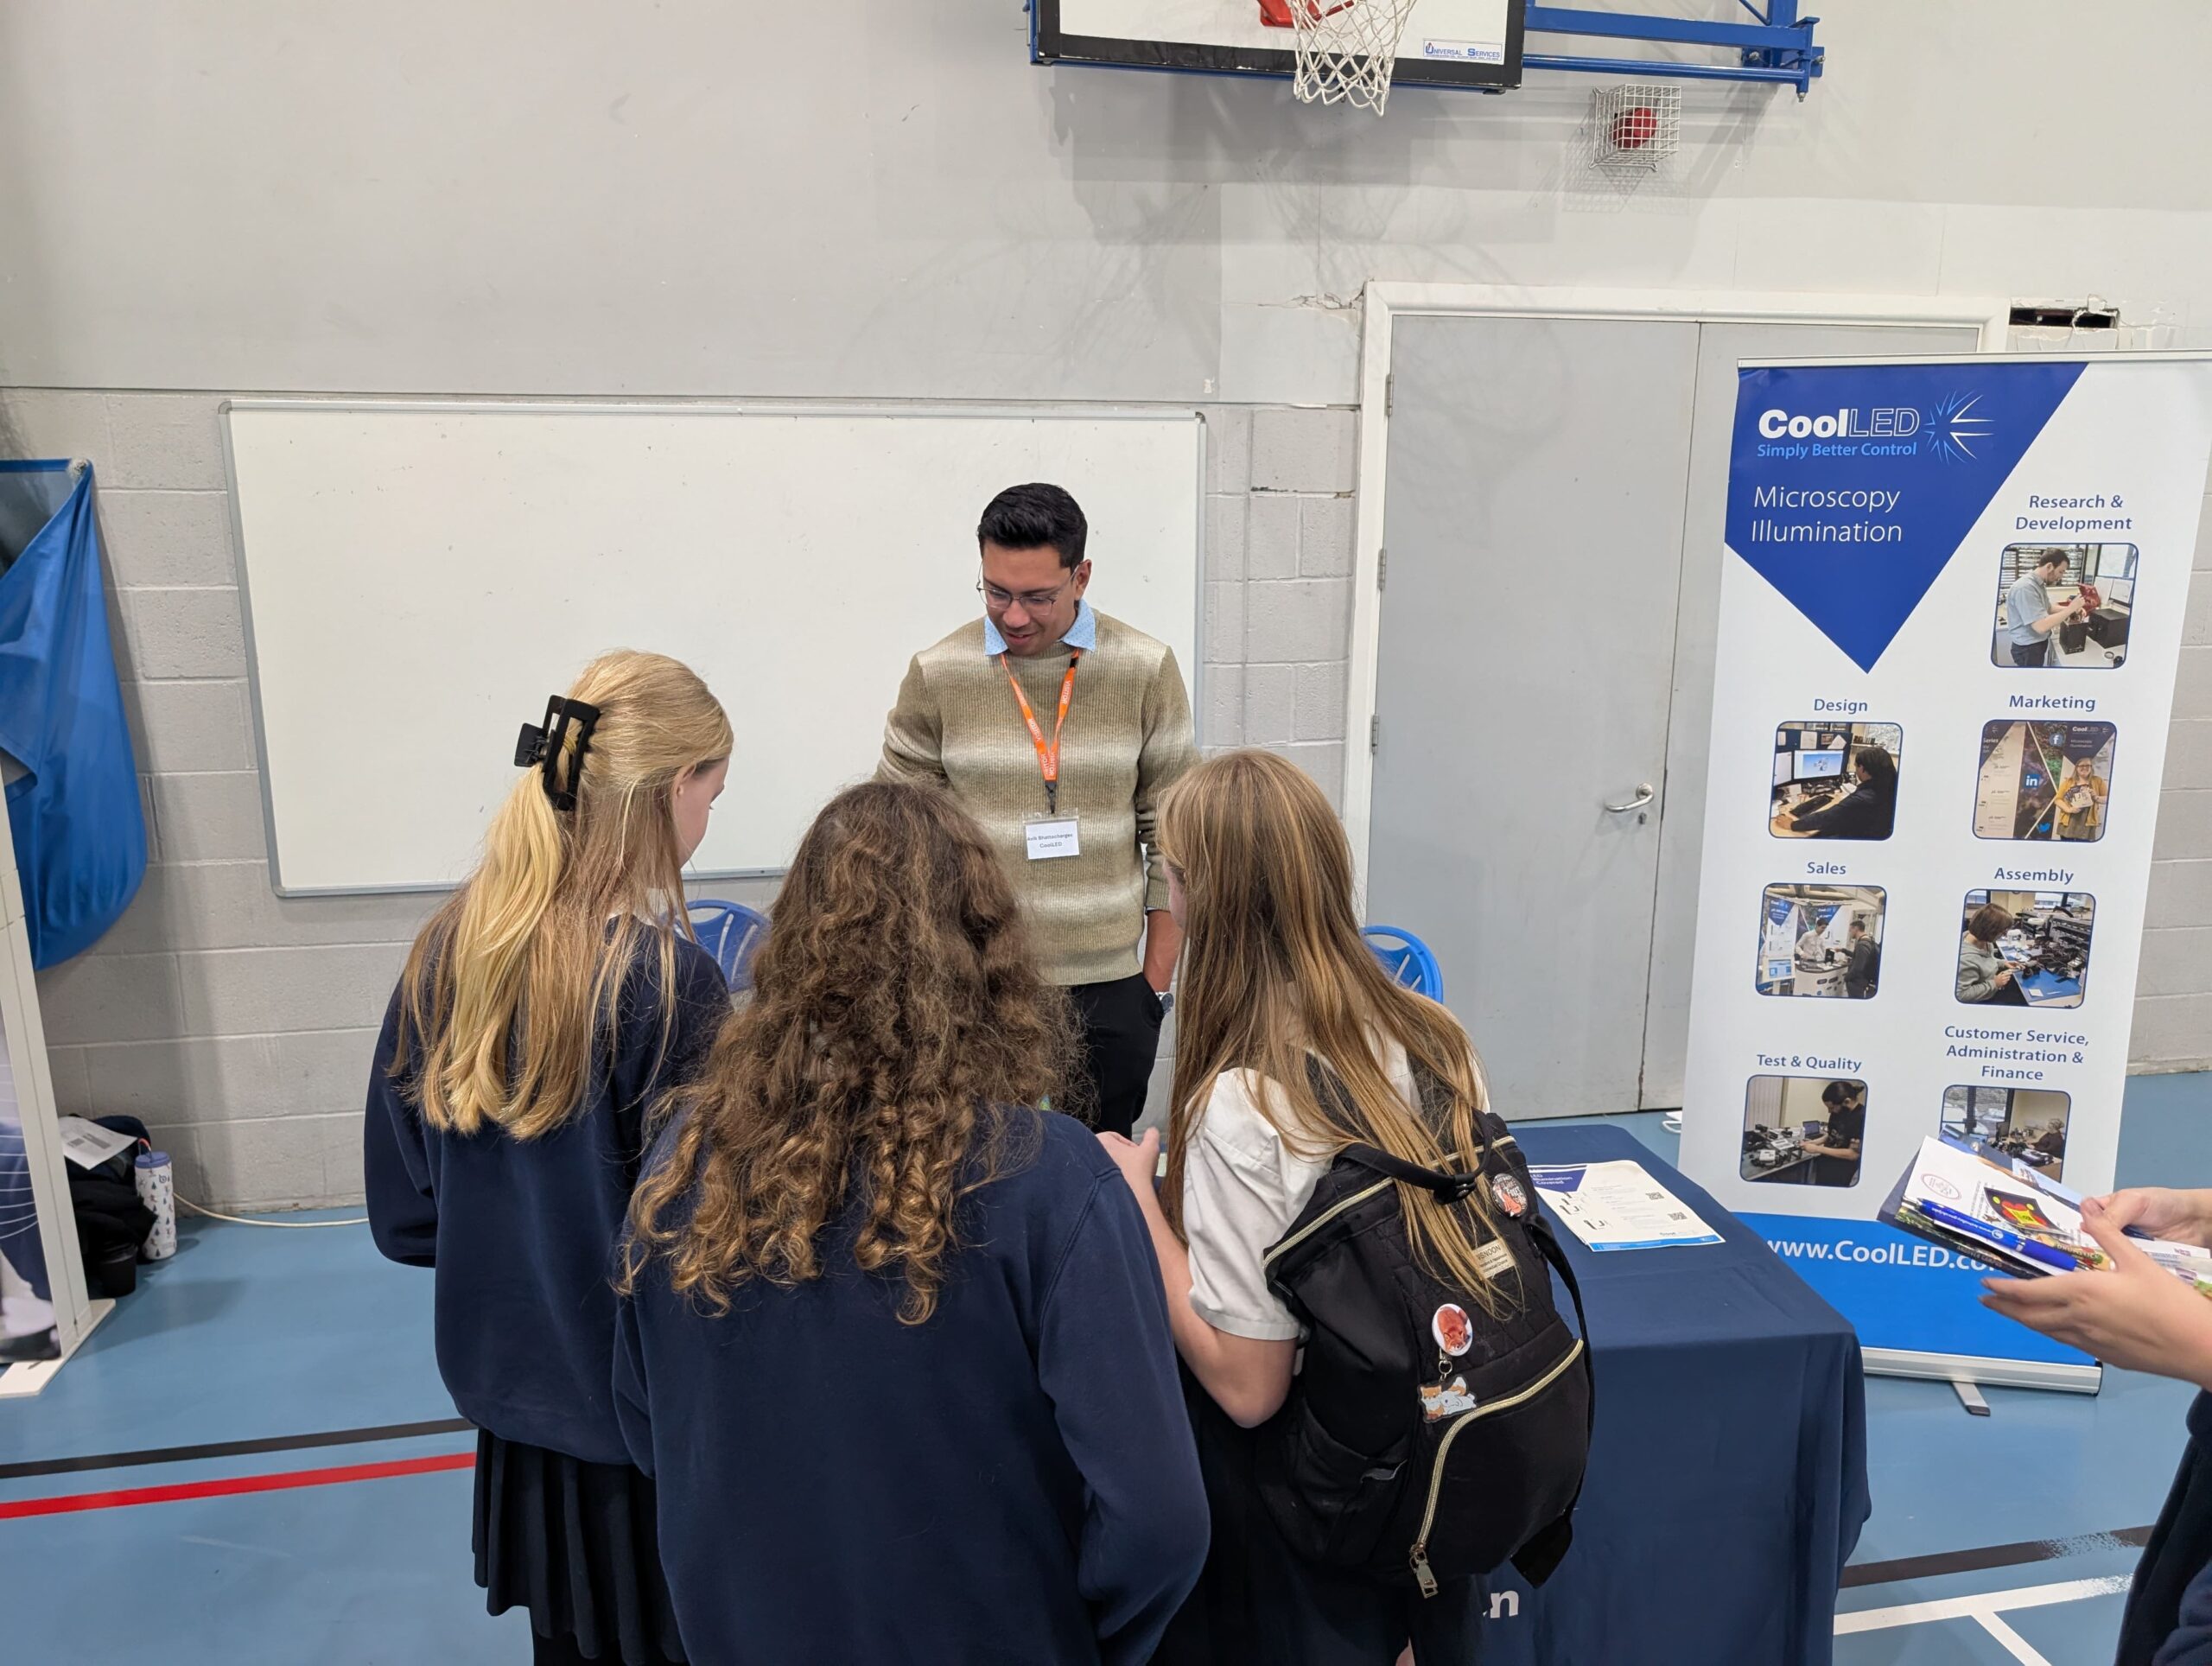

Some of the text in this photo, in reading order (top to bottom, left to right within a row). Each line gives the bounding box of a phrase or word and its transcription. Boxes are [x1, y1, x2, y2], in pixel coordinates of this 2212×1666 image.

[1426, 42, 1463, 56] UNIVERSAL
[1467, 48, 1500, 58] SERVICES
[1758, 408, 1920, 439] CoolLED
[1757, 442, 1916, 460] Simply Better Control
[1753, 486, 1901, 513] Microscopy
[2029, 494, 2123, 508] Research &
[1751, 519, 1902, 542] Illumination
[2016, 516, 2133, 532] Development
[1060, 680, 1071, 705] VISITOR
[1813, 698, 1868, 714] Design
[2009, 695, 2096, 712] Marketing
[1807, 862, 1847, 875] Sales
[1993, 867, 2074, 885] Assembly
[1944, 1026, 2089, 1046] Customer Service,
[1757, 1054, 1862, 1073] Test & Quality
[1946, 1045, 2084, 1064] Administration &
[1981, 1065, 2044, 1080] Finance
